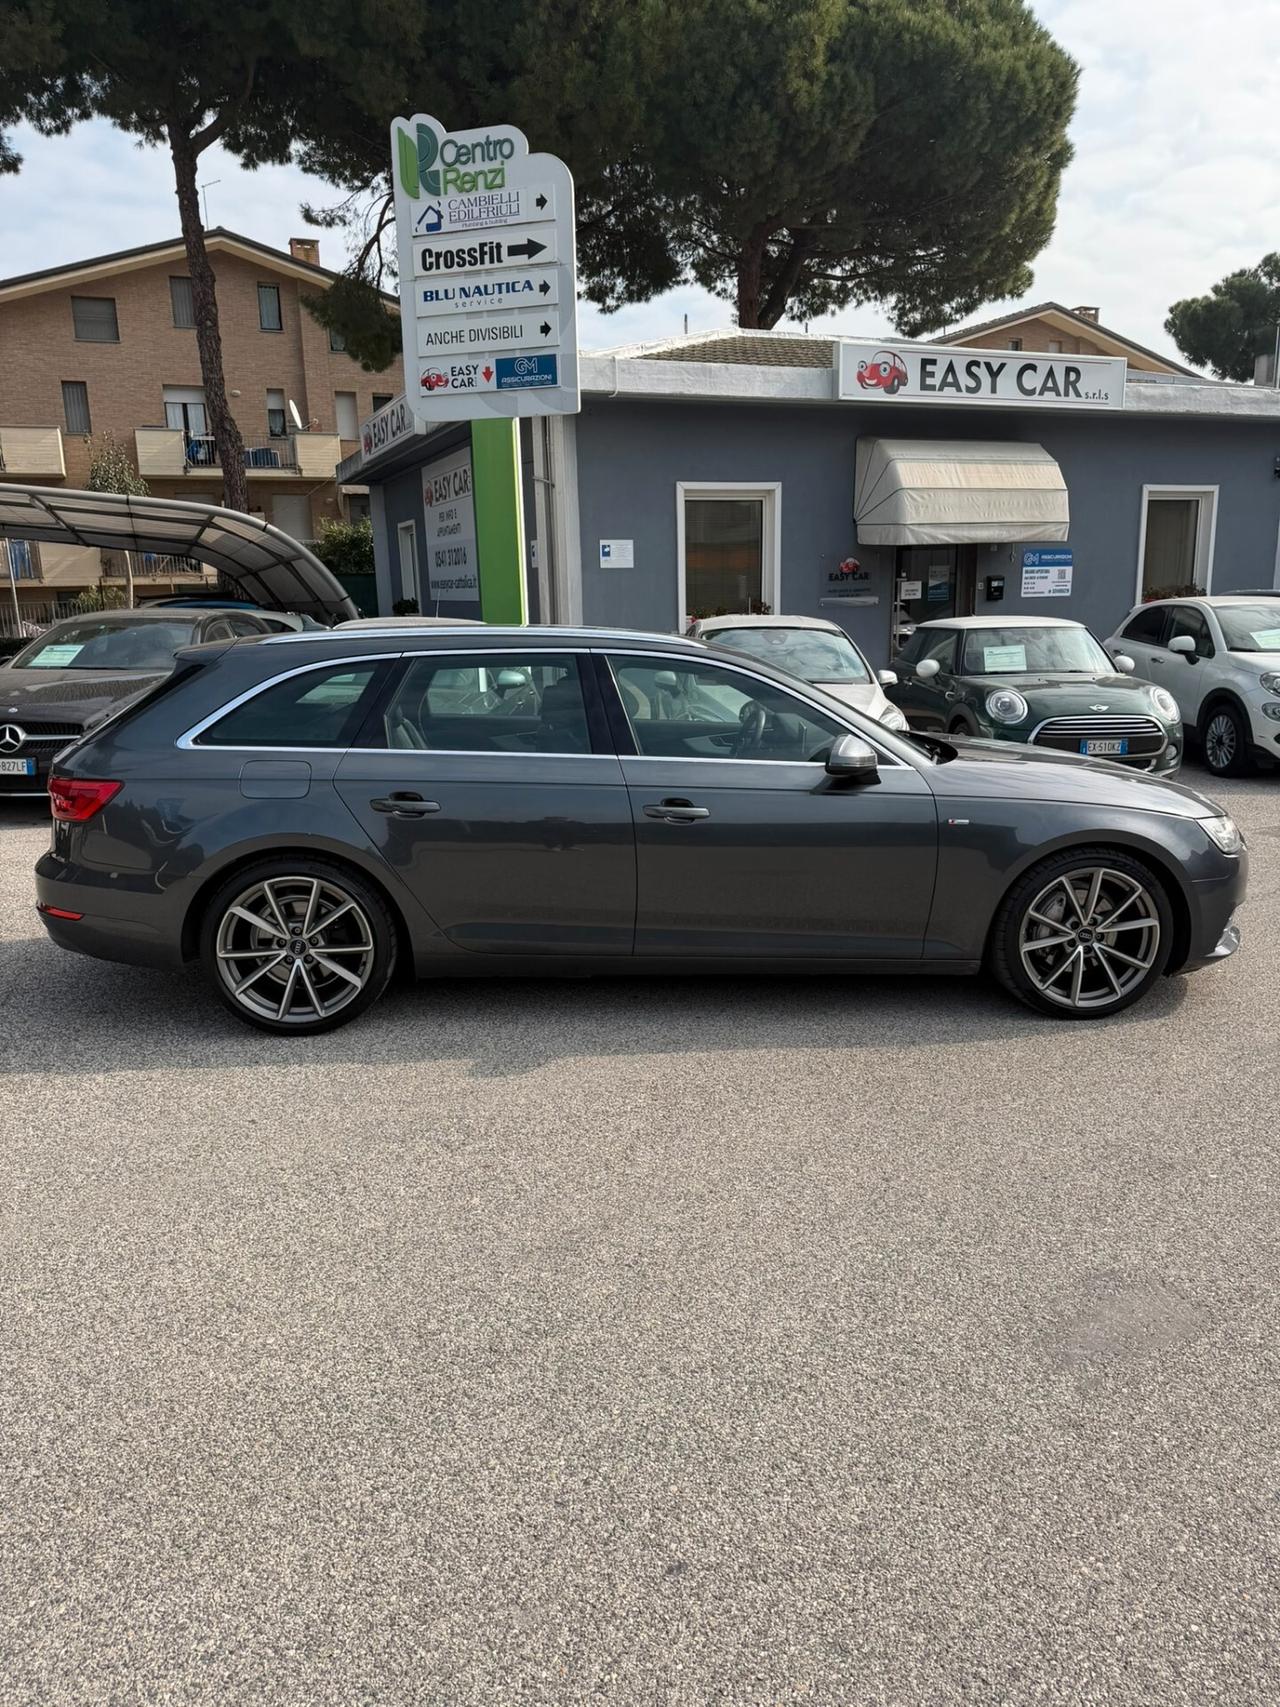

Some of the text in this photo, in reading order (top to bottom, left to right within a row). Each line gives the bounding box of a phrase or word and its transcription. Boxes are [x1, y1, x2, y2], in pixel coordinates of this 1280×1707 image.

[440, 134, 514, 167] Centro
[442, 160, 506, 195] Renzi
[448, 191, 520, 210] CAMBIELLI
[449, 203, 520, 221] EDILFRIULI
[421, 241, 503, 271] CrossFit
[423, 280, 534, 302] BLU NAUTICA
[455, 298, 503, 308] service
[426, 325, 523, 346] ANCHE DIVISIBILI
[450, 364, 479, 377] EASY
[919, 358, 1007, 394] EASY
[1016, 363, 1082, 398] CAR
[451, 376, 475, 388] CAR
[373, 403, 407, 449] EASY CAR
[434, 471, 451, 502] EASY
[452, 468, 470, 497] CAR
[828, 571, 869, 581] EASY CAR
